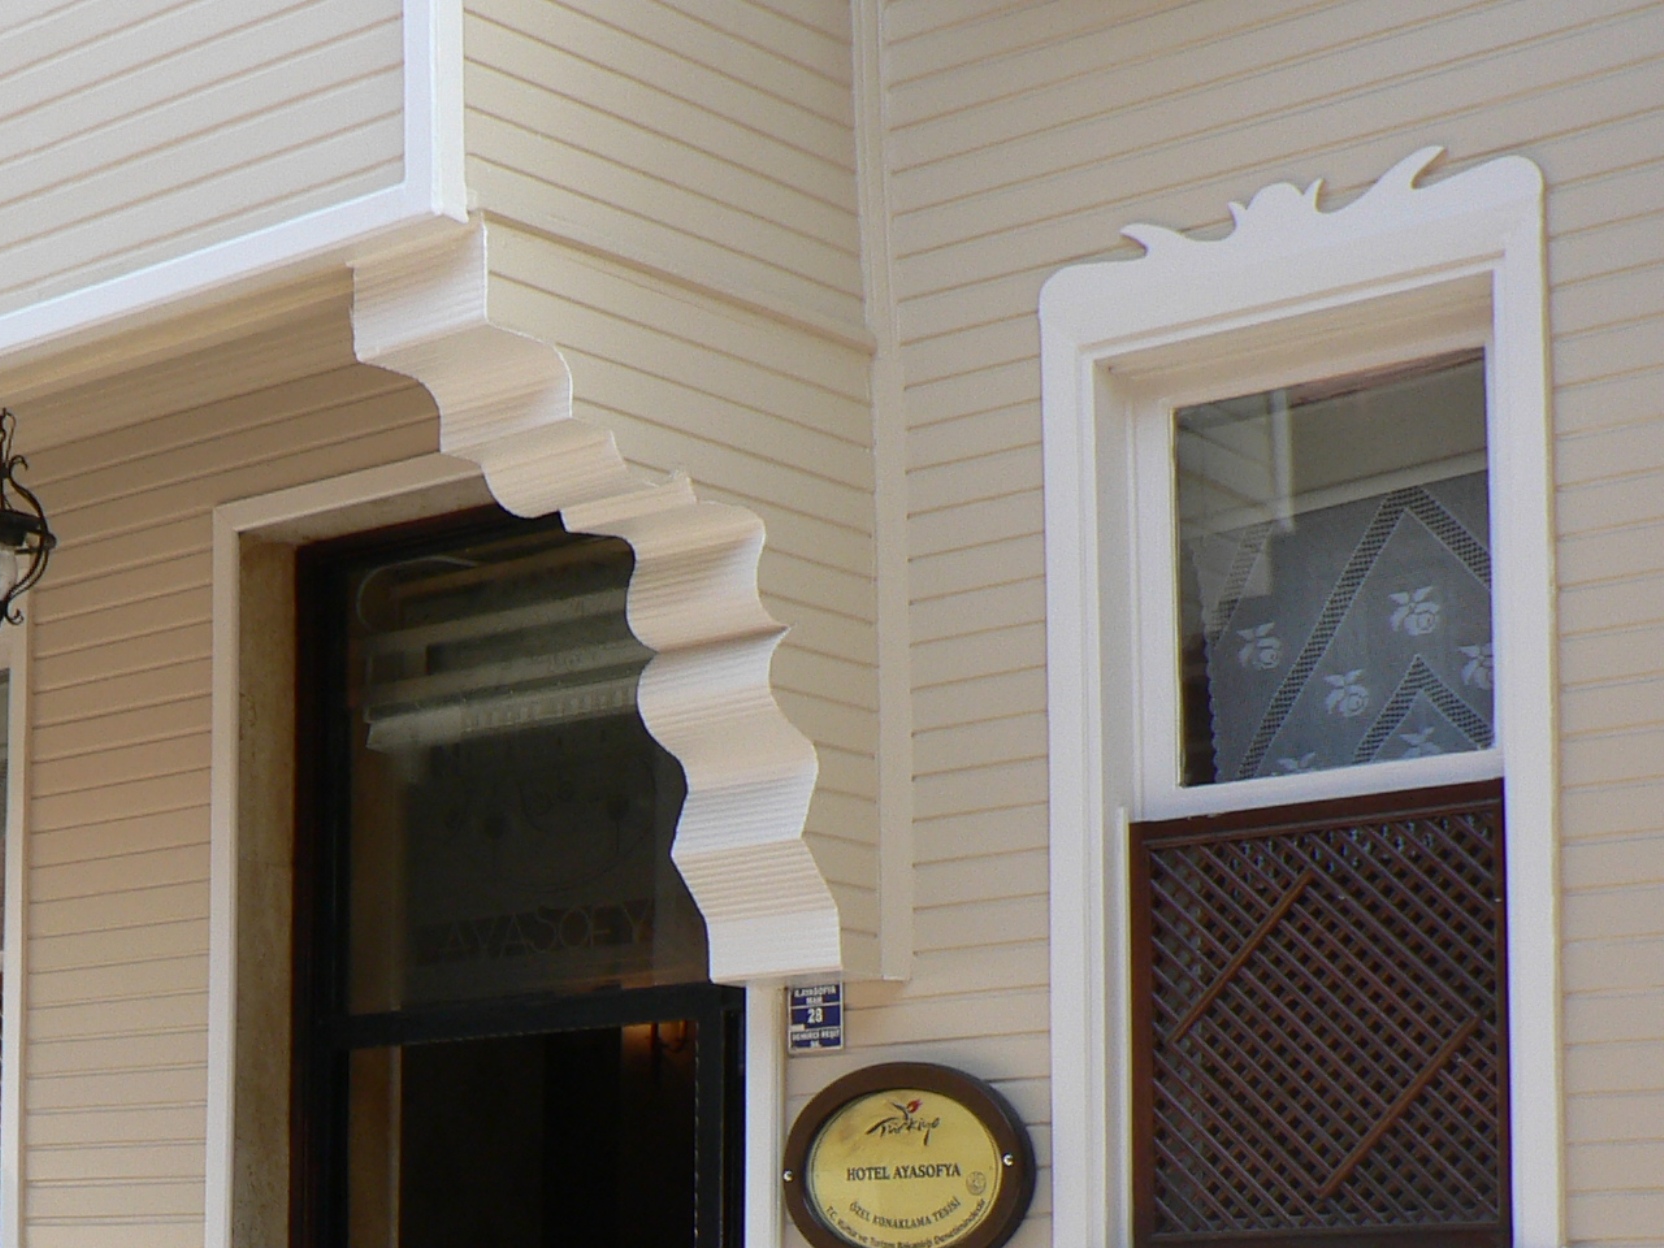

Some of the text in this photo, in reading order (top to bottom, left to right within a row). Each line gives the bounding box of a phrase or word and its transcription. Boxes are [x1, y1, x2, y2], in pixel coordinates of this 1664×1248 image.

[807, 1007, 823, 1023] 28
[866, 1117, 940, 1146] Türkiye
[847, 1163, 962, 1181] HOTEL AYASOFYA
[872, 1214, 932, 1229] KONAKLAMA
